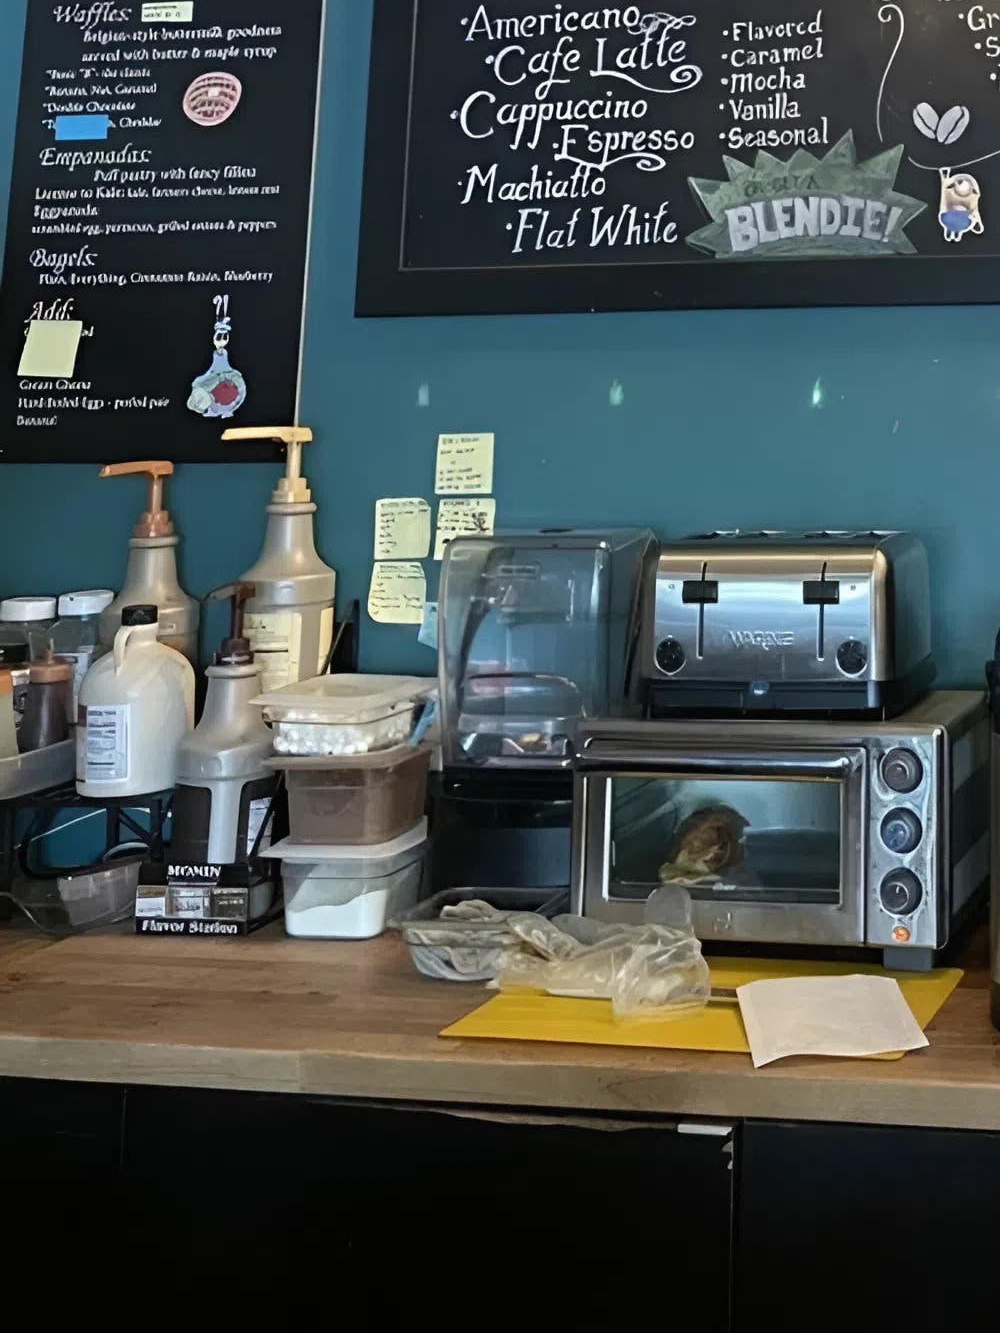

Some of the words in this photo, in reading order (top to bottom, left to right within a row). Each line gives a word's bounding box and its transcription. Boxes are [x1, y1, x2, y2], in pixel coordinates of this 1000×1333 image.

[466, 3, 641, 42] Americano
[732, 9, 823, 41] Flavored
[493, 36, 580, 101] Cafe
[590, 22, 702, 94] Latte
[730, 37, 824, 67] Caramel
[730, 66, 806, 94] Mocha
[459, 90, 648, 150] Cappuccino
[729, 92, 801, 121] Vanilla
[555, 123, 695, 172] Espresso
[728, 116, 829, 149] Seasonal
[461, 162, 606, 205] Machiatto
[511, 206, 577, 253] Flat
[590, 201, 678, 247] White
[724, 195, 903, 252] BLENDIE!
